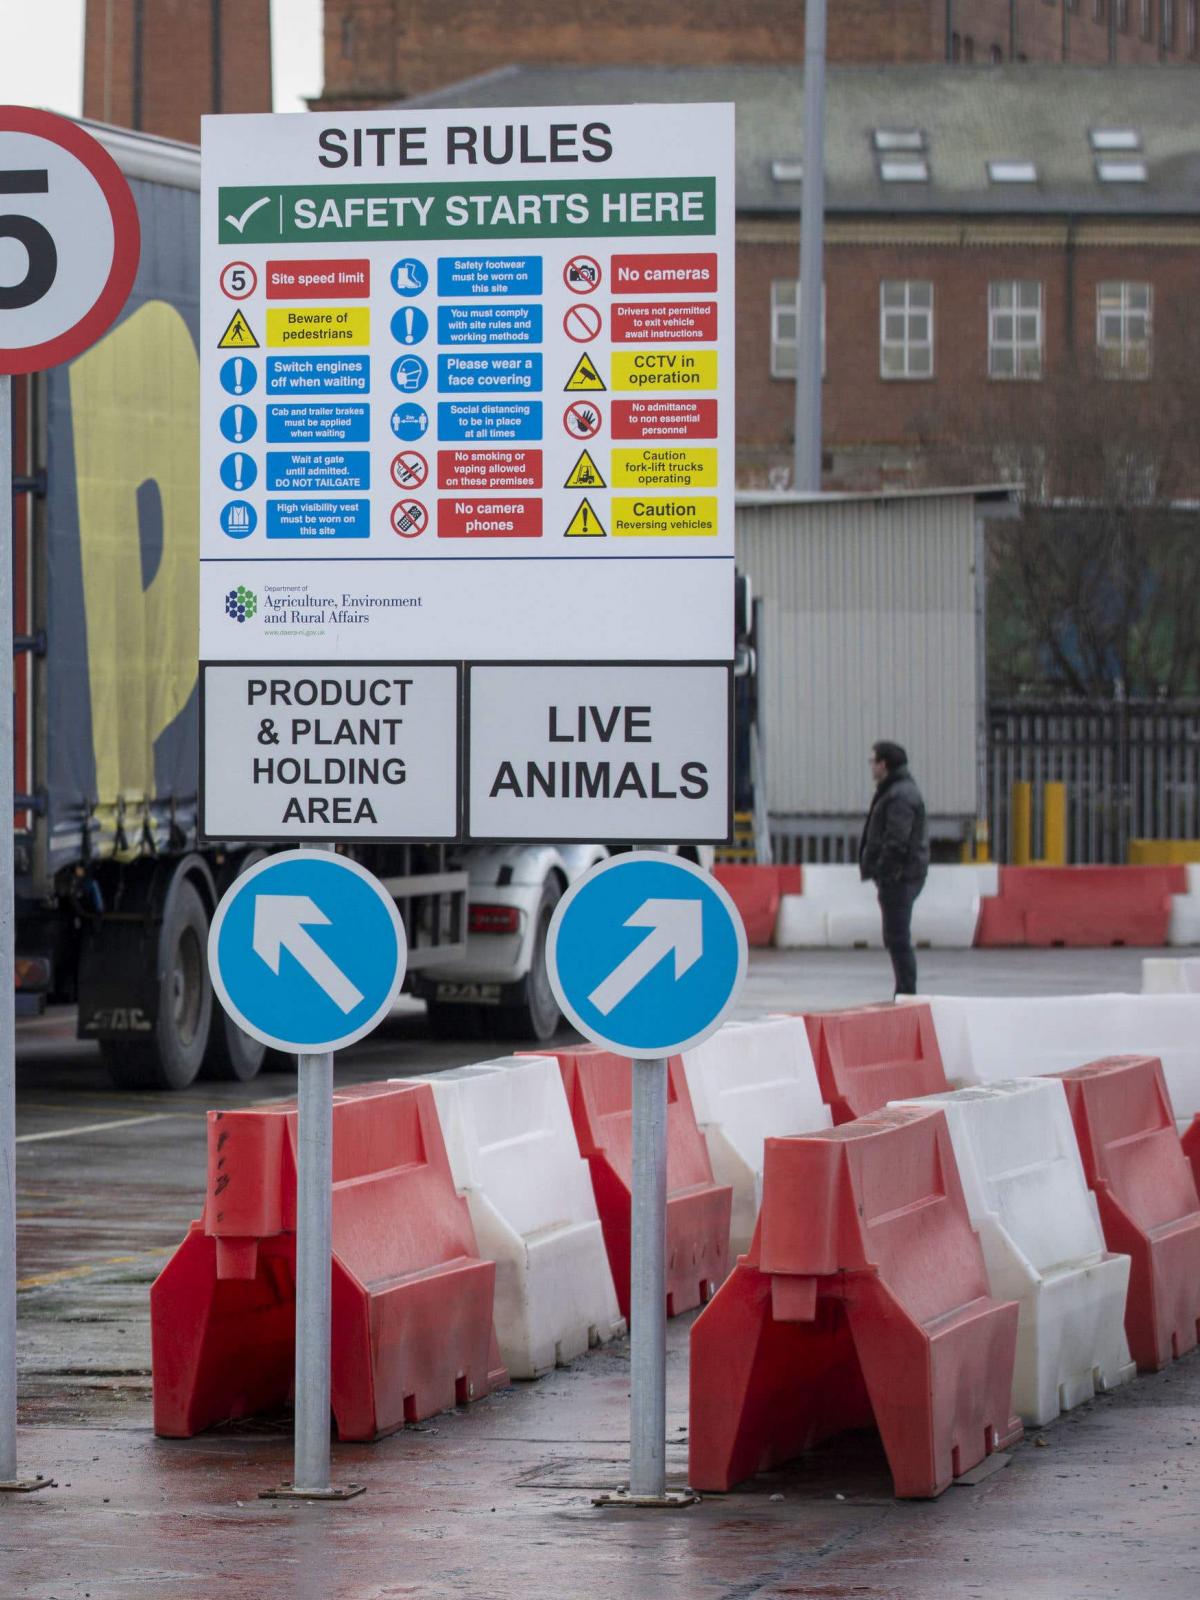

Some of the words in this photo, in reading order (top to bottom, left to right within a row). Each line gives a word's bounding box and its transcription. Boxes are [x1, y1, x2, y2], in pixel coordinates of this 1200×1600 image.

[318, 127, 427, 168] SITE
[447, 122, 612, 165] RULES
[294, 196, 435, 229] SAFETY
[446, 193, 589, 226] STARTS
[603, 191, 704, 222] HERE
[454, 260, 484, 271] Safety
[485, 260, 526, 269] footwear
[272, 273, 295, 285] Site
[298, 272, 335, 286] speed
[338, 272, 364, 283] limit
[452, 273, 475, 281] must
[476, 272, 489, 281] be
[491, 273, 514, 281] worn
[618, 267, 640, 281] No
[644, 269, 710, 280] cameras
[231, 270, 246, 291] 5
[472, 284, 489, 293] this
[491, 284, 508, 292] site
[451, 309, 468, 318] You
[470, 309, 493, 318] must
[495, 308, 528, 319] comply
[618, 307, 650, 315] Drivers
[668, 306, 710, 316] permitted
[288, 313, 332, 324] Beware
[336, 312, 348, 323] of
[634, 319, 642, 327] to
[644, 318, 660, 326] exit
[662, 318, 694, 326] vehicle
[448, 321, 468, 329] with
[470, 320, 486, 329] site
[488, 320, 512, 329] rules
[514, 320, 531, 328] and
[283, 328, 352, 342] pedestrians
[450, 332, 487, 342] working
[489, 331, 529, 341] methods
[625, 330, 648, 338] await
[651, 329, 703, 338] instructions
[447, 358, 488, 370] Please
[492, 360, 522, 369] wear
[525, 360, 532, 368] a
[634, 355, 676, 368] CCTV
[682, 355, 694, 368] in
[274, 361, 312, 372] Switch
[316, 361, 362, 374] engines
[271, 377, 287, 387] off
[290, 376, 320, 387] when
[324, 376, 365, 389] waiting
[448, 374, 474, 385] face
[478, 373, 531, 388] covering
[629, 371, 700, 387] operation
[272, 408, 289, 416] Cab
[290, 408, 307, 416] and
[308, 407, 334, 416] trailer
[336, 407, 364, 415] brakes
[450, 405, 480, 414] Social
[482, 405, 530, 416] distancing
[632, 403, 645, 411] No
[647, 402, 697, 411] admittance
[284, 419, 305, 427] must
[306, 418, 318, 426] be
[320, 418, 352, 428] applied
[459, 418, 468, 426] to
[470, 417, 482, 426] be
[485, 417, 494, 425] in
[496, 417, 522, 427] place
[629, 415, 638, 423] to
[660, 414, 700, 423] essential
[315, 429, 345, 439] waiting
[476, 429, 488, 437] all
[489, 429, 515, 437] times
[642, 426, 687, 435] personnel
[292, 456, 312, 464] Wait
[313, 456, 322, 464] at
[324, 456, 344, 465] gate
[455, 453, 469, 463] No
[471, 452, 512, 463] smoking
[643, 451, 686, 460] Caution
[286, 467, 306, 475] until
[308, 467, 349, 475] admitted.
[454, 464, 486, 475] vaping
[489, 464, 526, 475] allowed
[626, 462, 666, 472] fork-lift
[668, 462, 704, 472] trucks
[276, 478, 290, 487] DO
[292, 478, 313, 487] NOT
[315, 478, 360, 487] TAILGATE
[446, 478, 458, 486] on
[460, 476, 487, 486] these
[490, 476, 534, 485] premises
[638, 474, 691, 484] operating
[277, 503, 298, 514] High
[300, 503, 338, 513] visibility
[340, 504, 359, 512] vest
[455, 502, 473, 514] No
[477, 504, 524, 514] camera
[633, 502, 696, 516] Caution
[280, 515, 303, 524] must
[304, 515, 317, 523] be
[300, 526, 317, 535] this
[319, 526, 336, 535] site
[466, 519, 514, 533] phones
[616, 520, 667, 531] Reversing
[670, 520, 712, 528] vehicles
[264, 595, 337, 611] Agriculture,
[342, 594, 422, 607] Environment
[264, 611, 287, 623] and
[292, 611, 324, 623] Rural
[329, 610, 369, 623] Affairs
[248, 679, 413, 706] PRODUCT
[549, 706, 652, 743] LIVE
[257, 718, 280, 745] &
[292, 719, 402, 745] PLANT
[254, 758, 406, 785] HOLDING
[489, 761, 708, 799] ANIMALS
[282, 797, 378, 824] AREA
